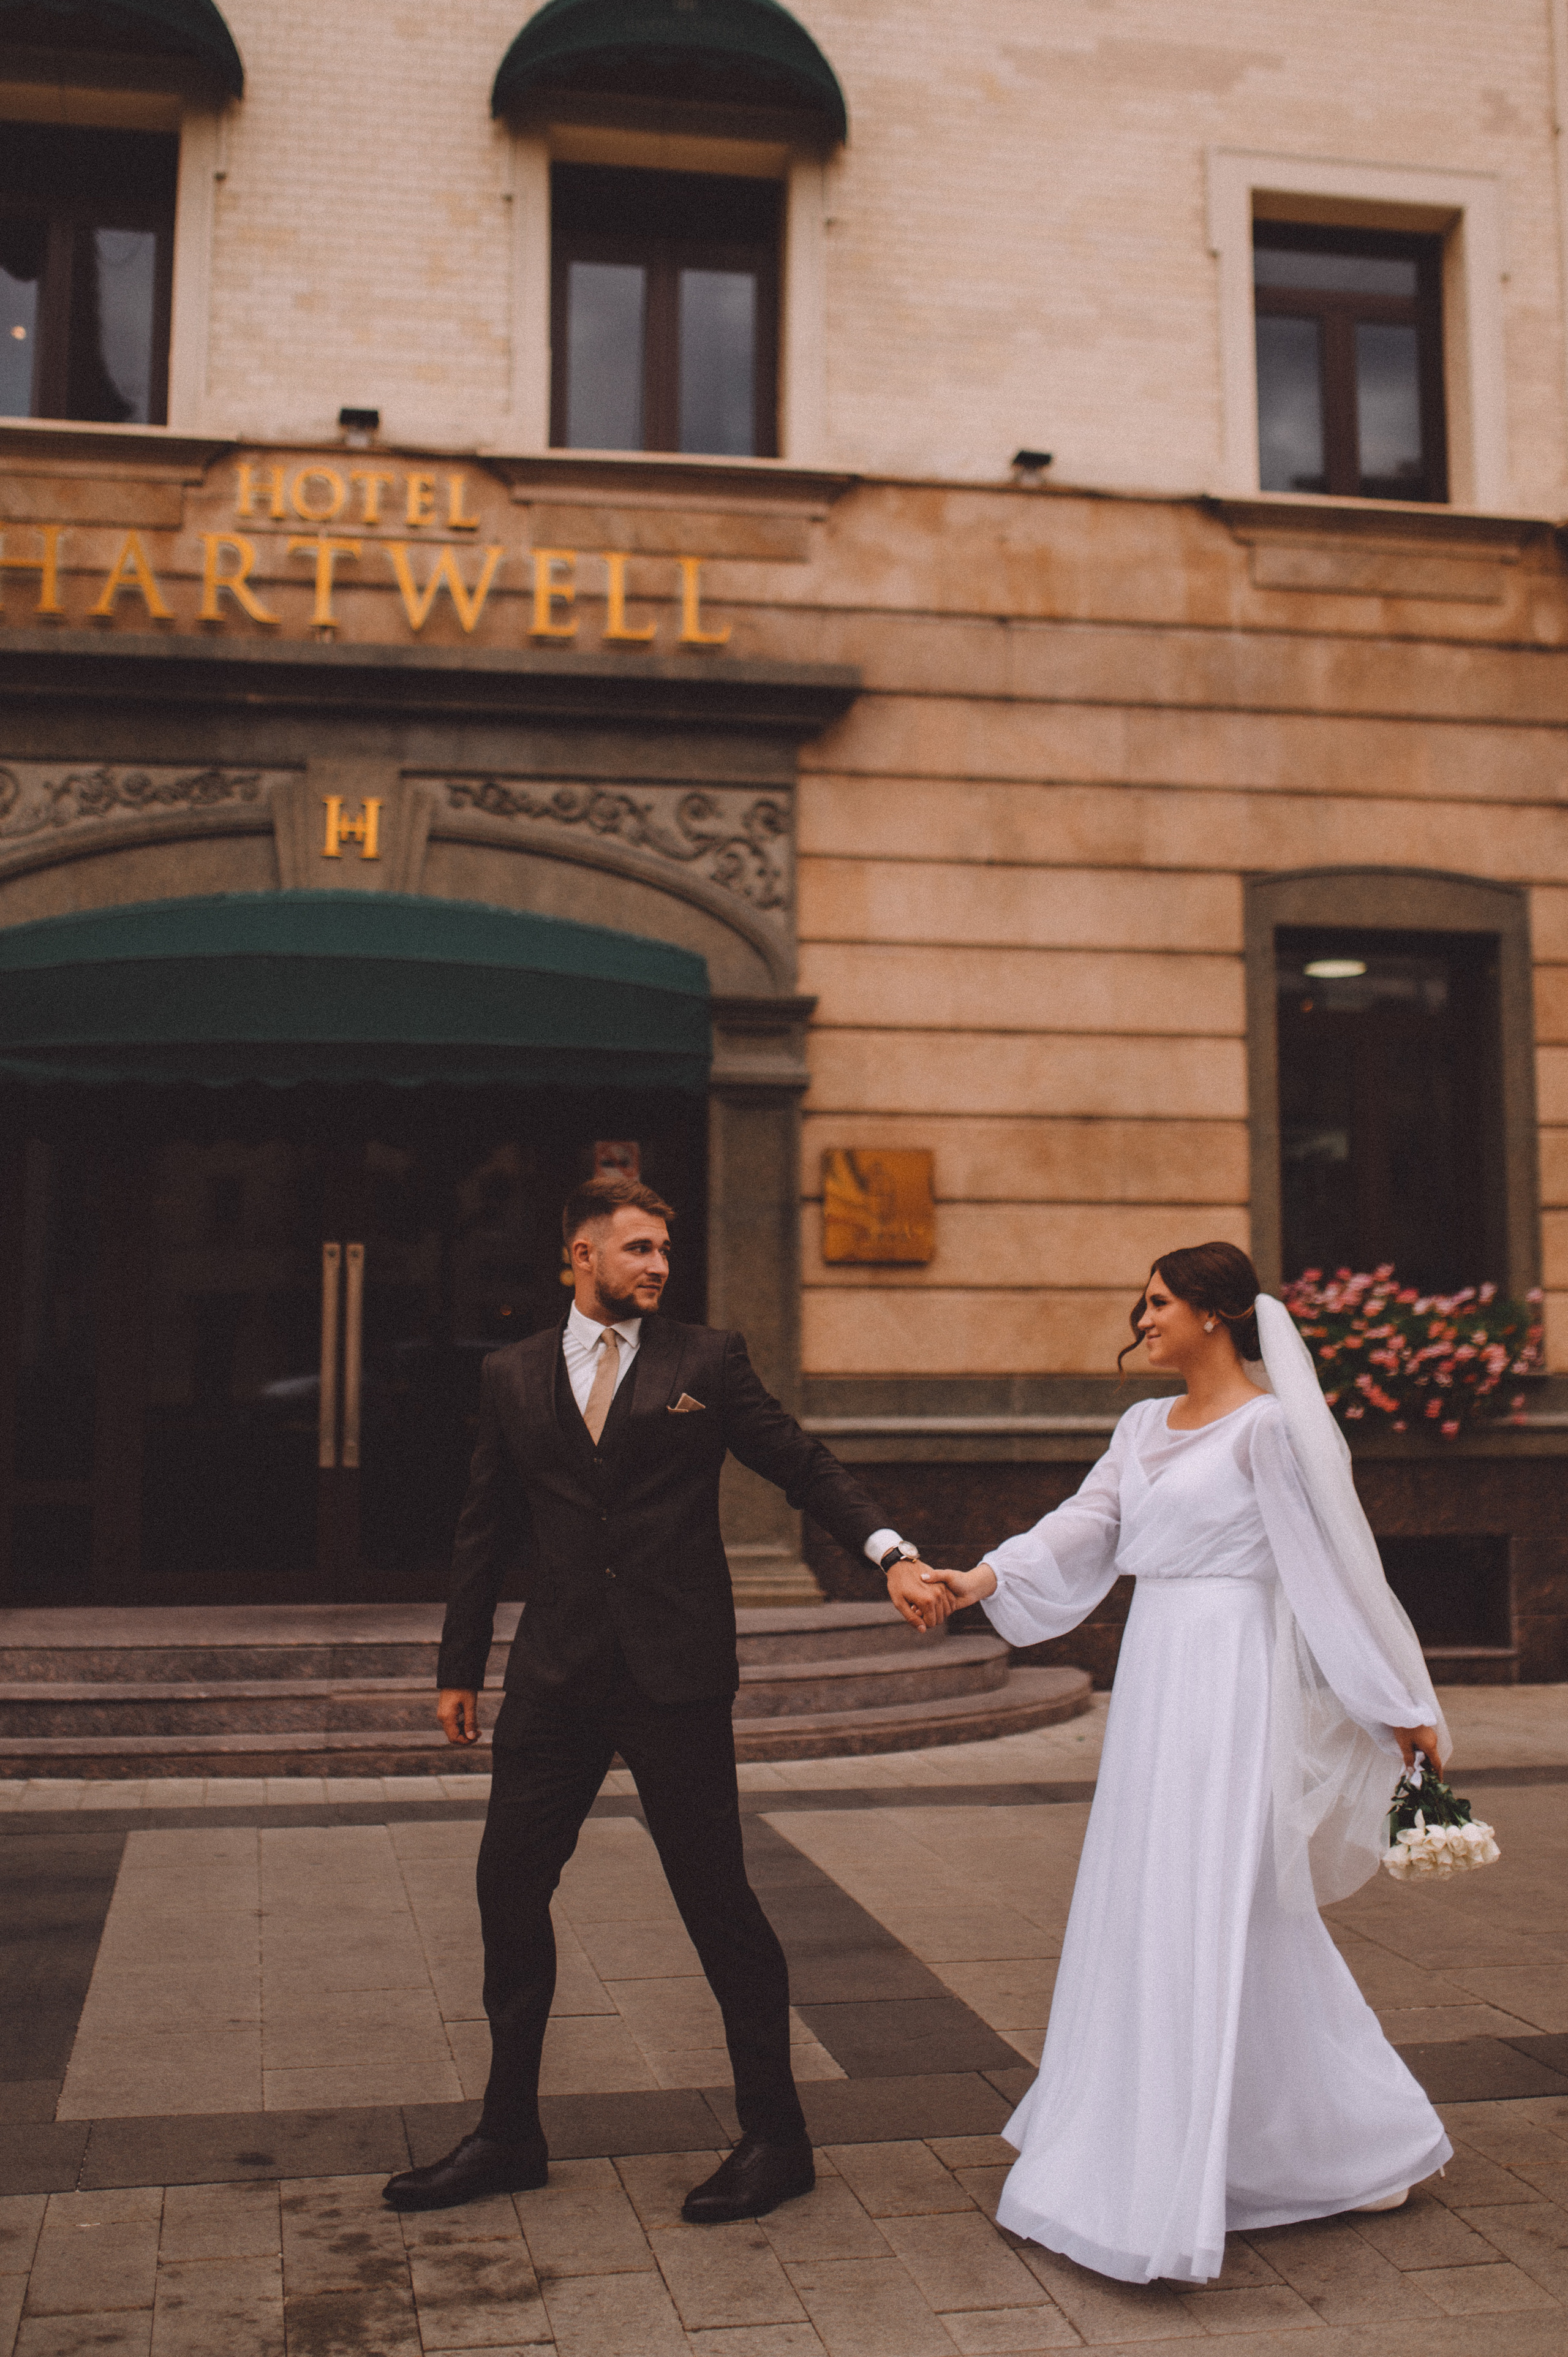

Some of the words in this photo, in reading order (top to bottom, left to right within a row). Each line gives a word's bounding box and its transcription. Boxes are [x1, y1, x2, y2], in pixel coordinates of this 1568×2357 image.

[235, 463, 480, 527] HOTEL
[0, 524, 731, 643] HARTWELL
[320, 795, 383, 858] H
